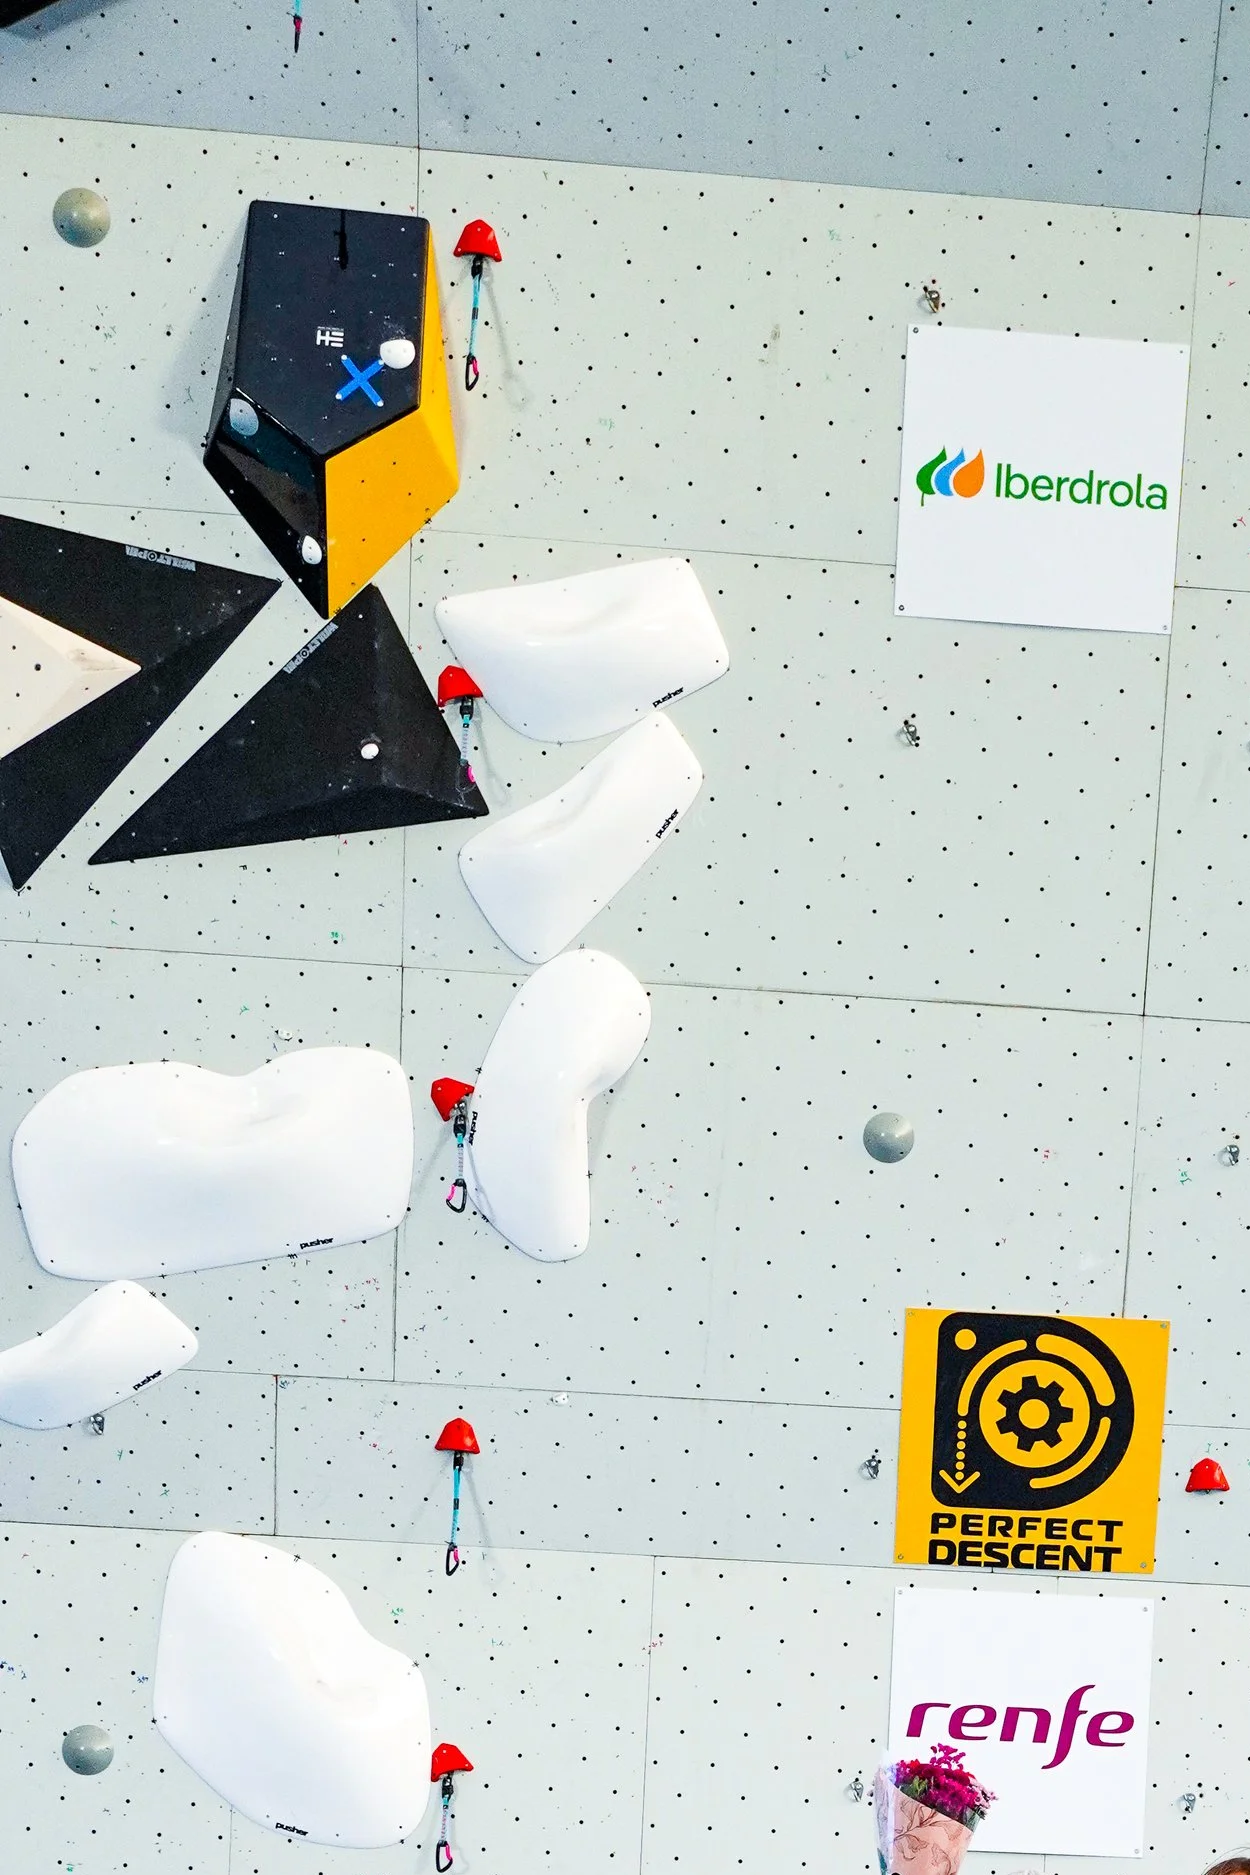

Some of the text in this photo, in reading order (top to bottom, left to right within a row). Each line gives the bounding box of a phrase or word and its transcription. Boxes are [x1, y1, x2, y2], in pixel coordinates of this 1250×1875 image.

[996, 464, 1168, 510] Iberdrola
[653, 687, 683, 708] pusher
[656, 809, 678, 839] pusher
[469, 1111, 478, 1146] pusher
[300, 1238, 333, 1249] pusher
[133, 1370, 162, 1391] pusher
[930, 1512, 1123, 1542] PERFECT
[928, 1539, 1122, 1572] DESCENT
[906, 1684, 1135, 1770] renfe
[275, 1822, 308, 1836] pusher
